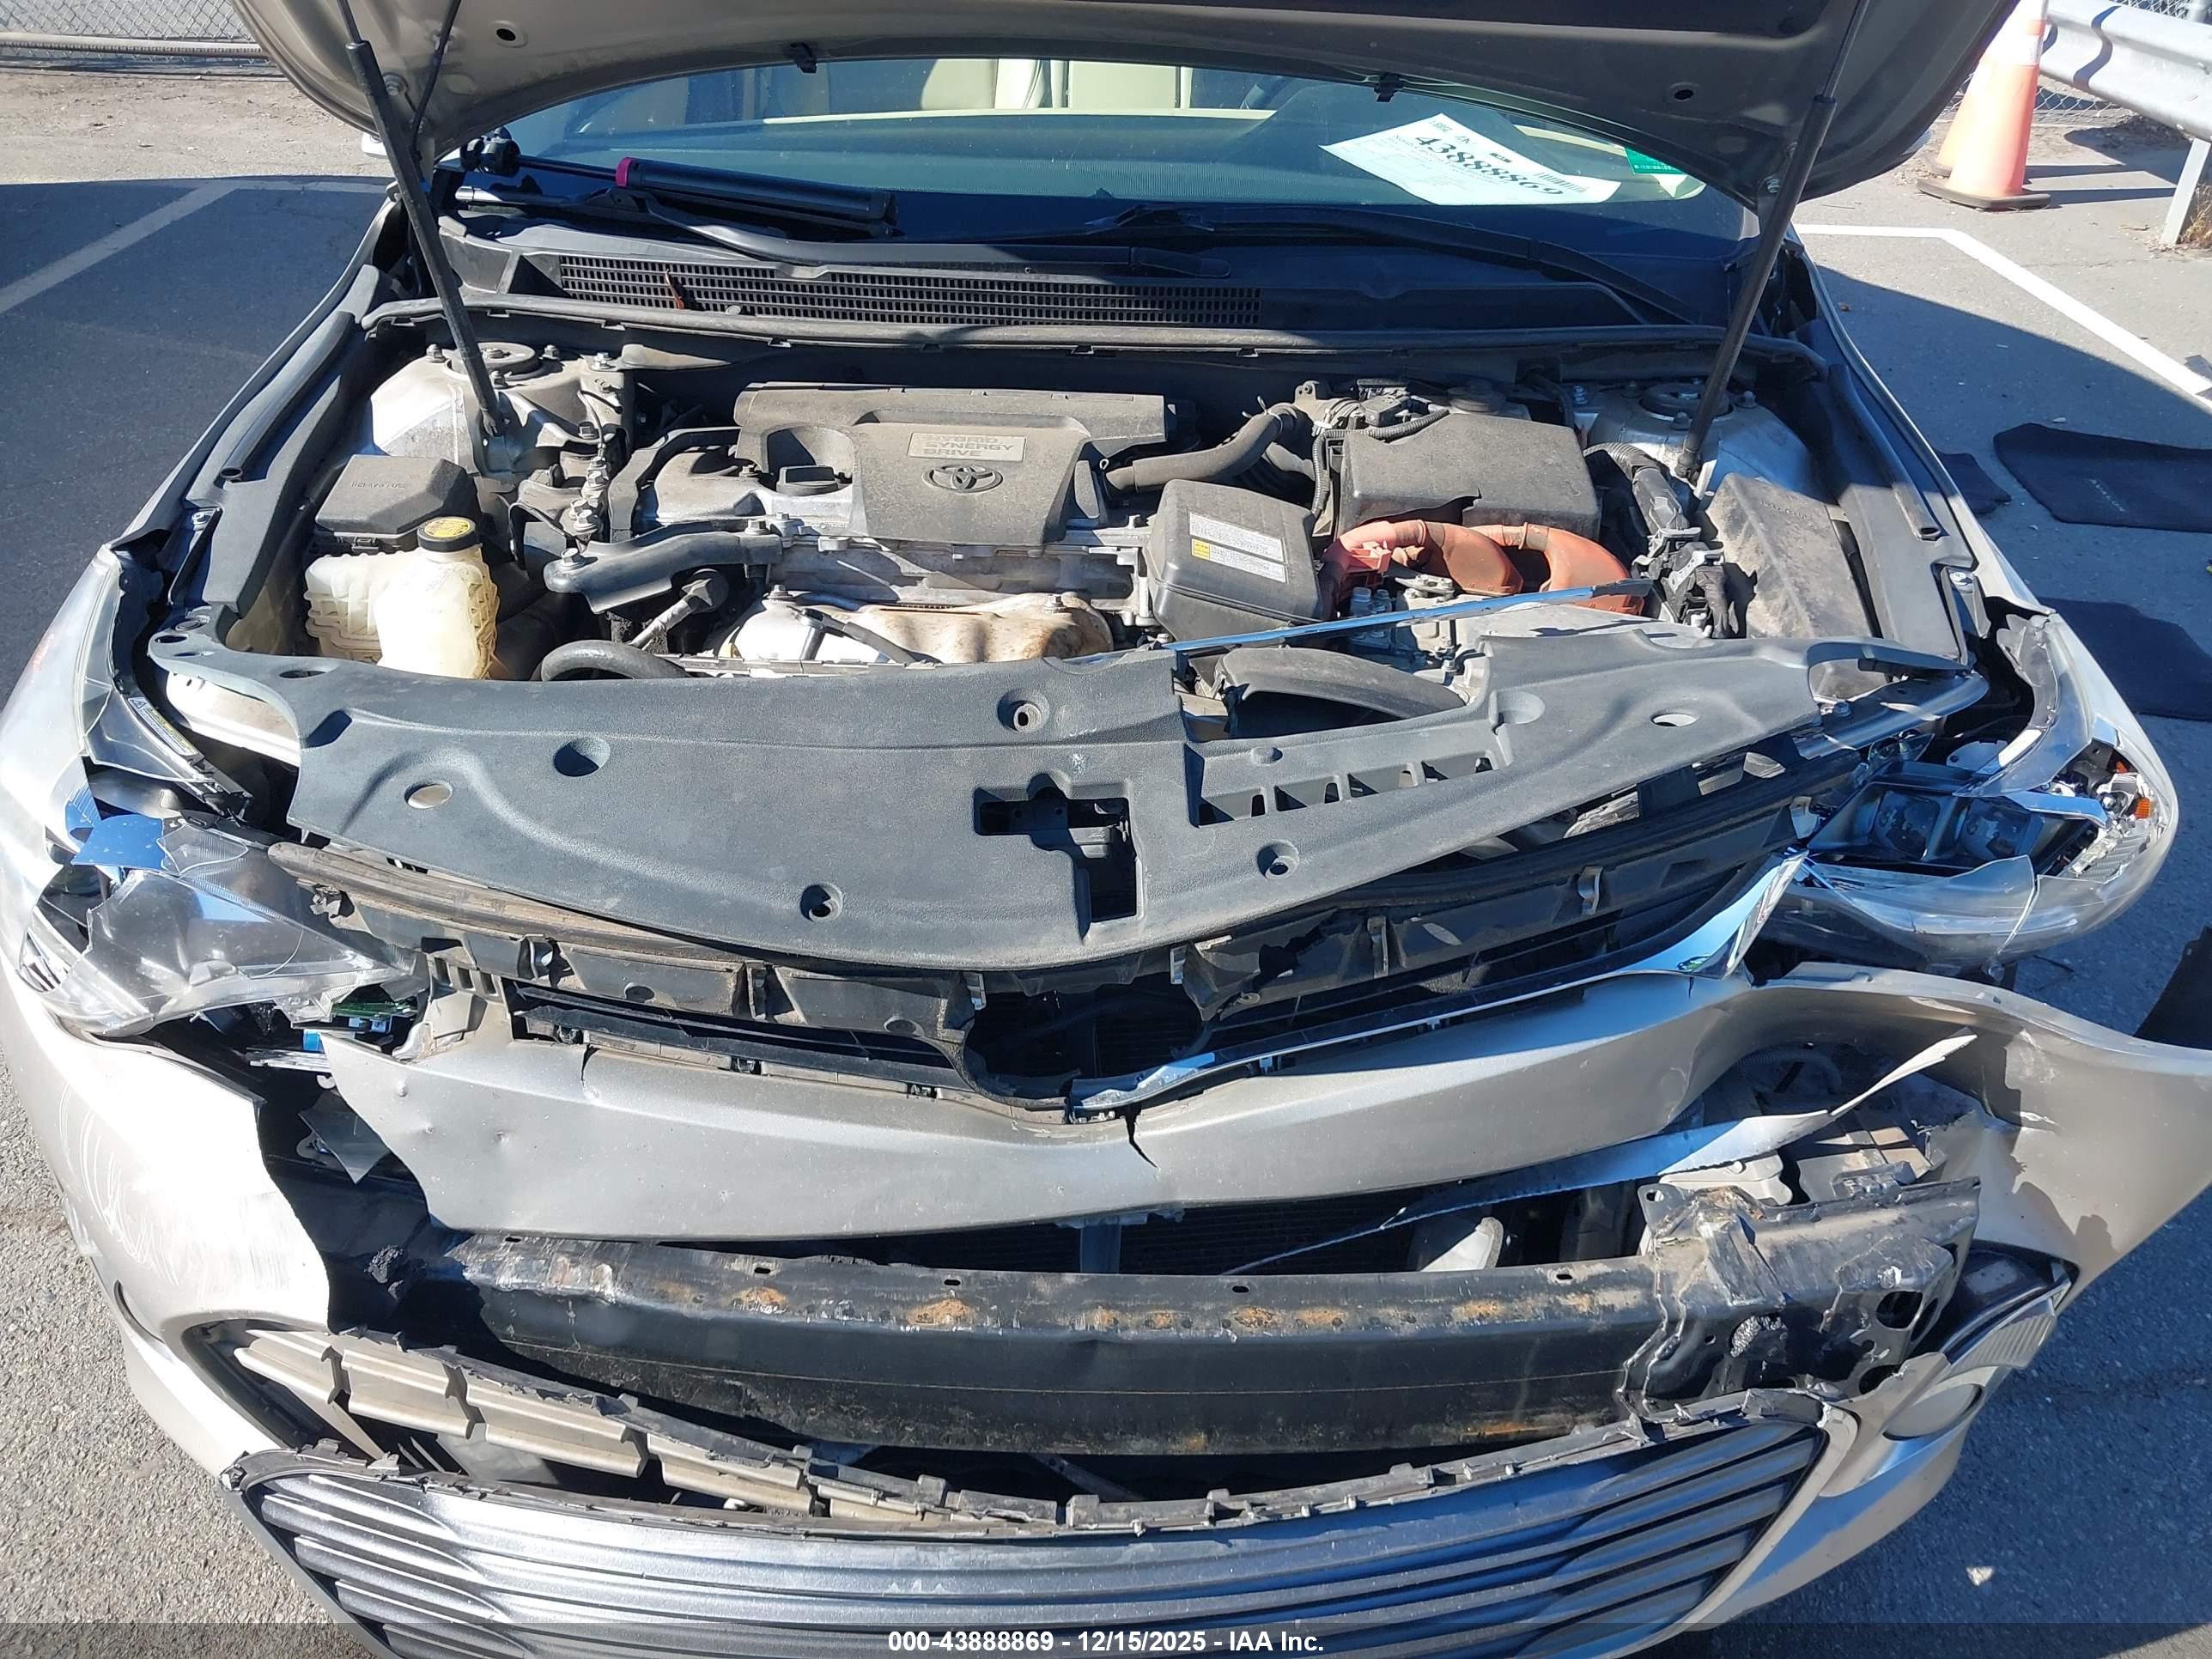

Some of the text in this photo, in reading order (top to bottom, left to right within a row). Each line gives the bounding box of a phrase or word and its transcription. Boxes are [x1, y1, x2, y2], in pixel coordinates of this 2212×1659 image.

[1415, 137, 1564, 194] 43888869
[926, 441, 1014, 451] SYNERGY
[923, 448, 982, 457] DRIVE
